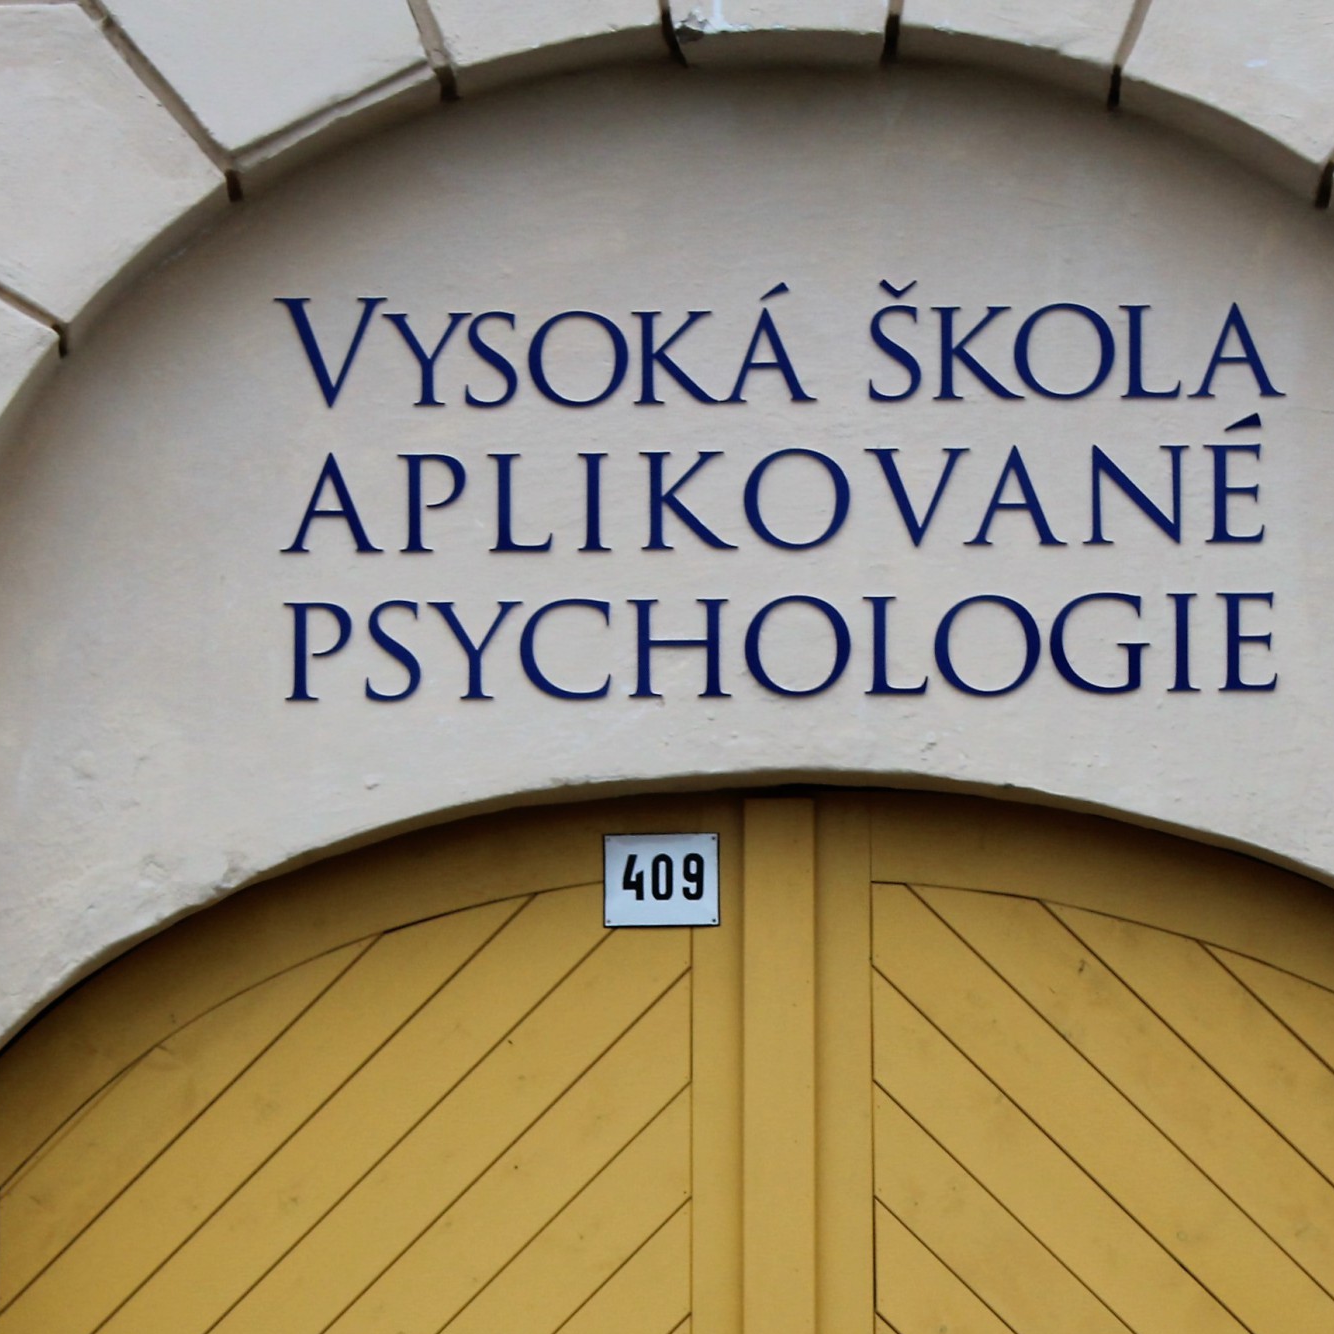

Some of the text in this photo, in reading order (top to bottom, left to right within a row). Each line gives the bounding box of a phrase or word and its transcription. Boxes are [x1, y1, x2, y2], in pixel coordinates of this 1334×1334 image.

[274, 278, 1286, 408] VYSOKÁ ŠKOLA
[279, 411, 1266, 553] APLIKOVANÉ
[283, 591, 1278, 702] PSYCHOLOGIE
[621, 852, 706, 902] 409
